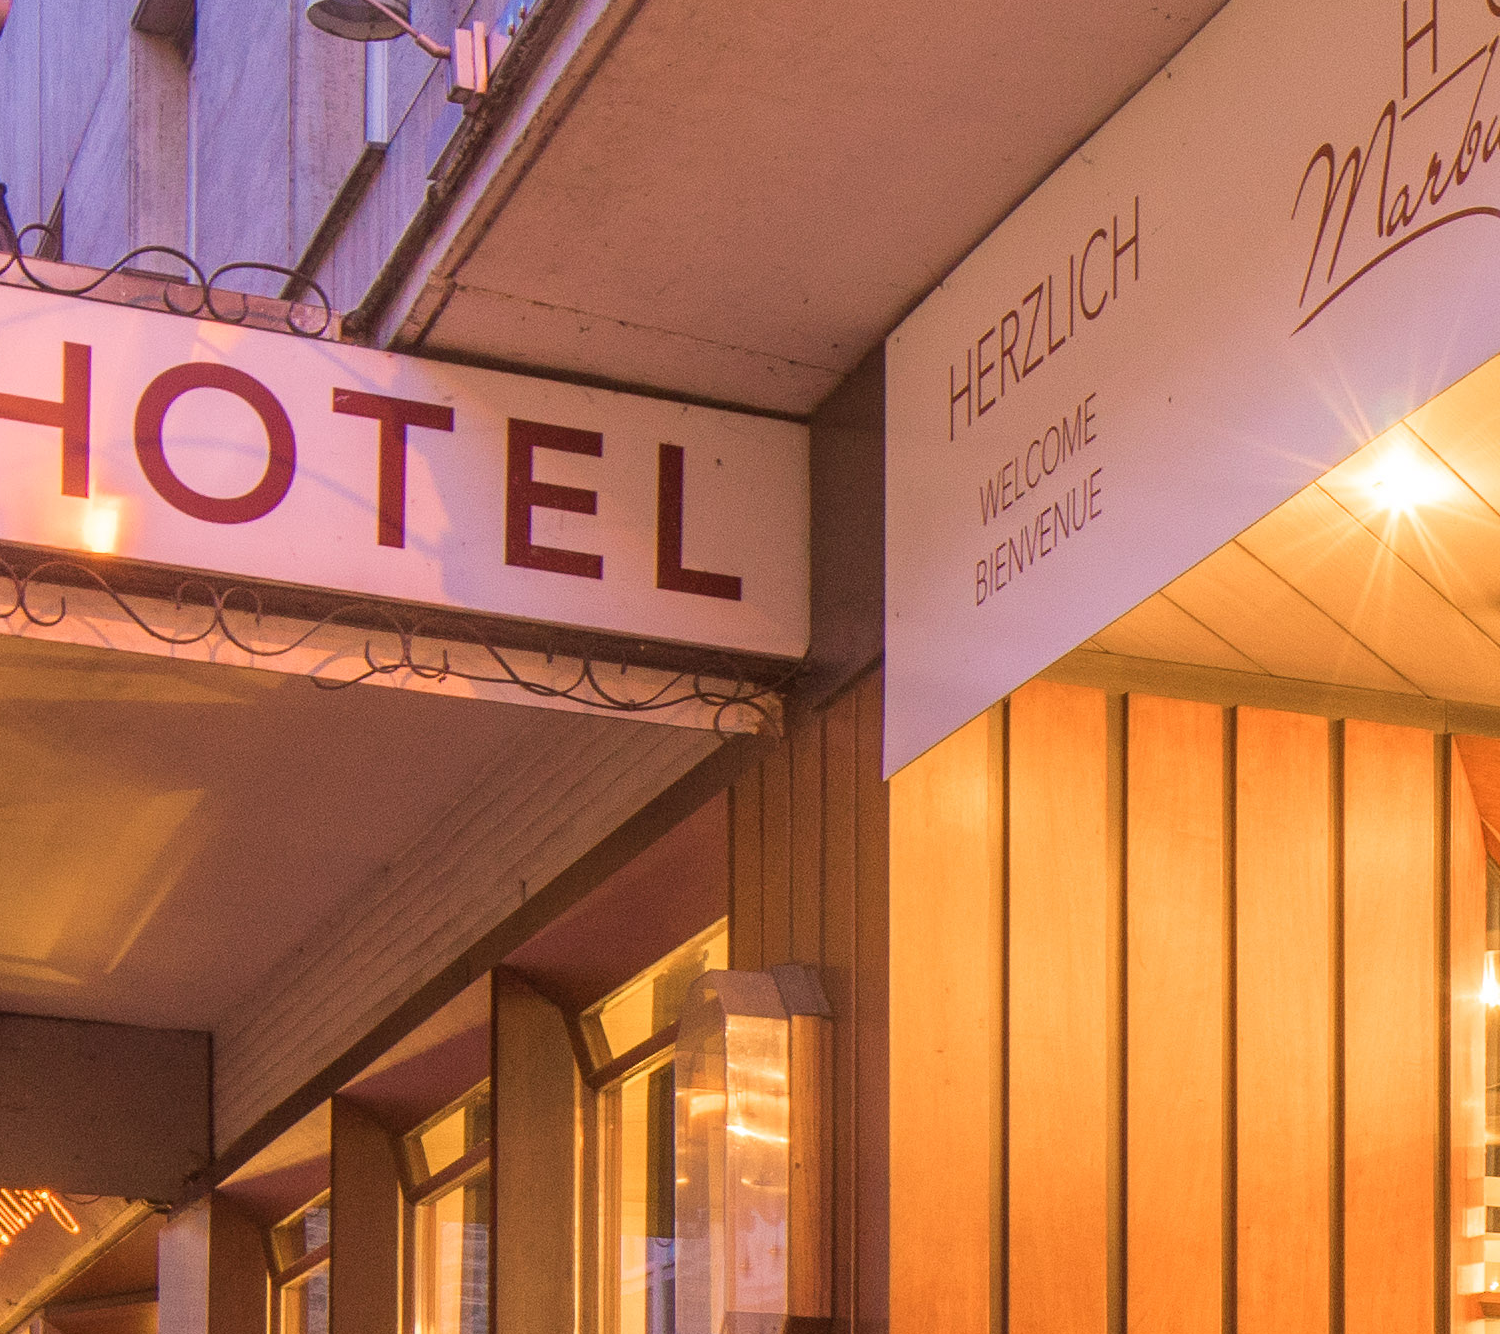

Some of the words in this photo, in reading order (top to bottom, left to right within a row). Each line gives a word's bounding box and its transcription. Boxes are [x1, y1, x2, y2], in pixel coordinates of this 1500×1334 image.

[948, 194, 1141, 443] HERZLICH
[979, 391, 1099, 527] WELCOME
[975, 467, 1104, 607] BIENVENUE
